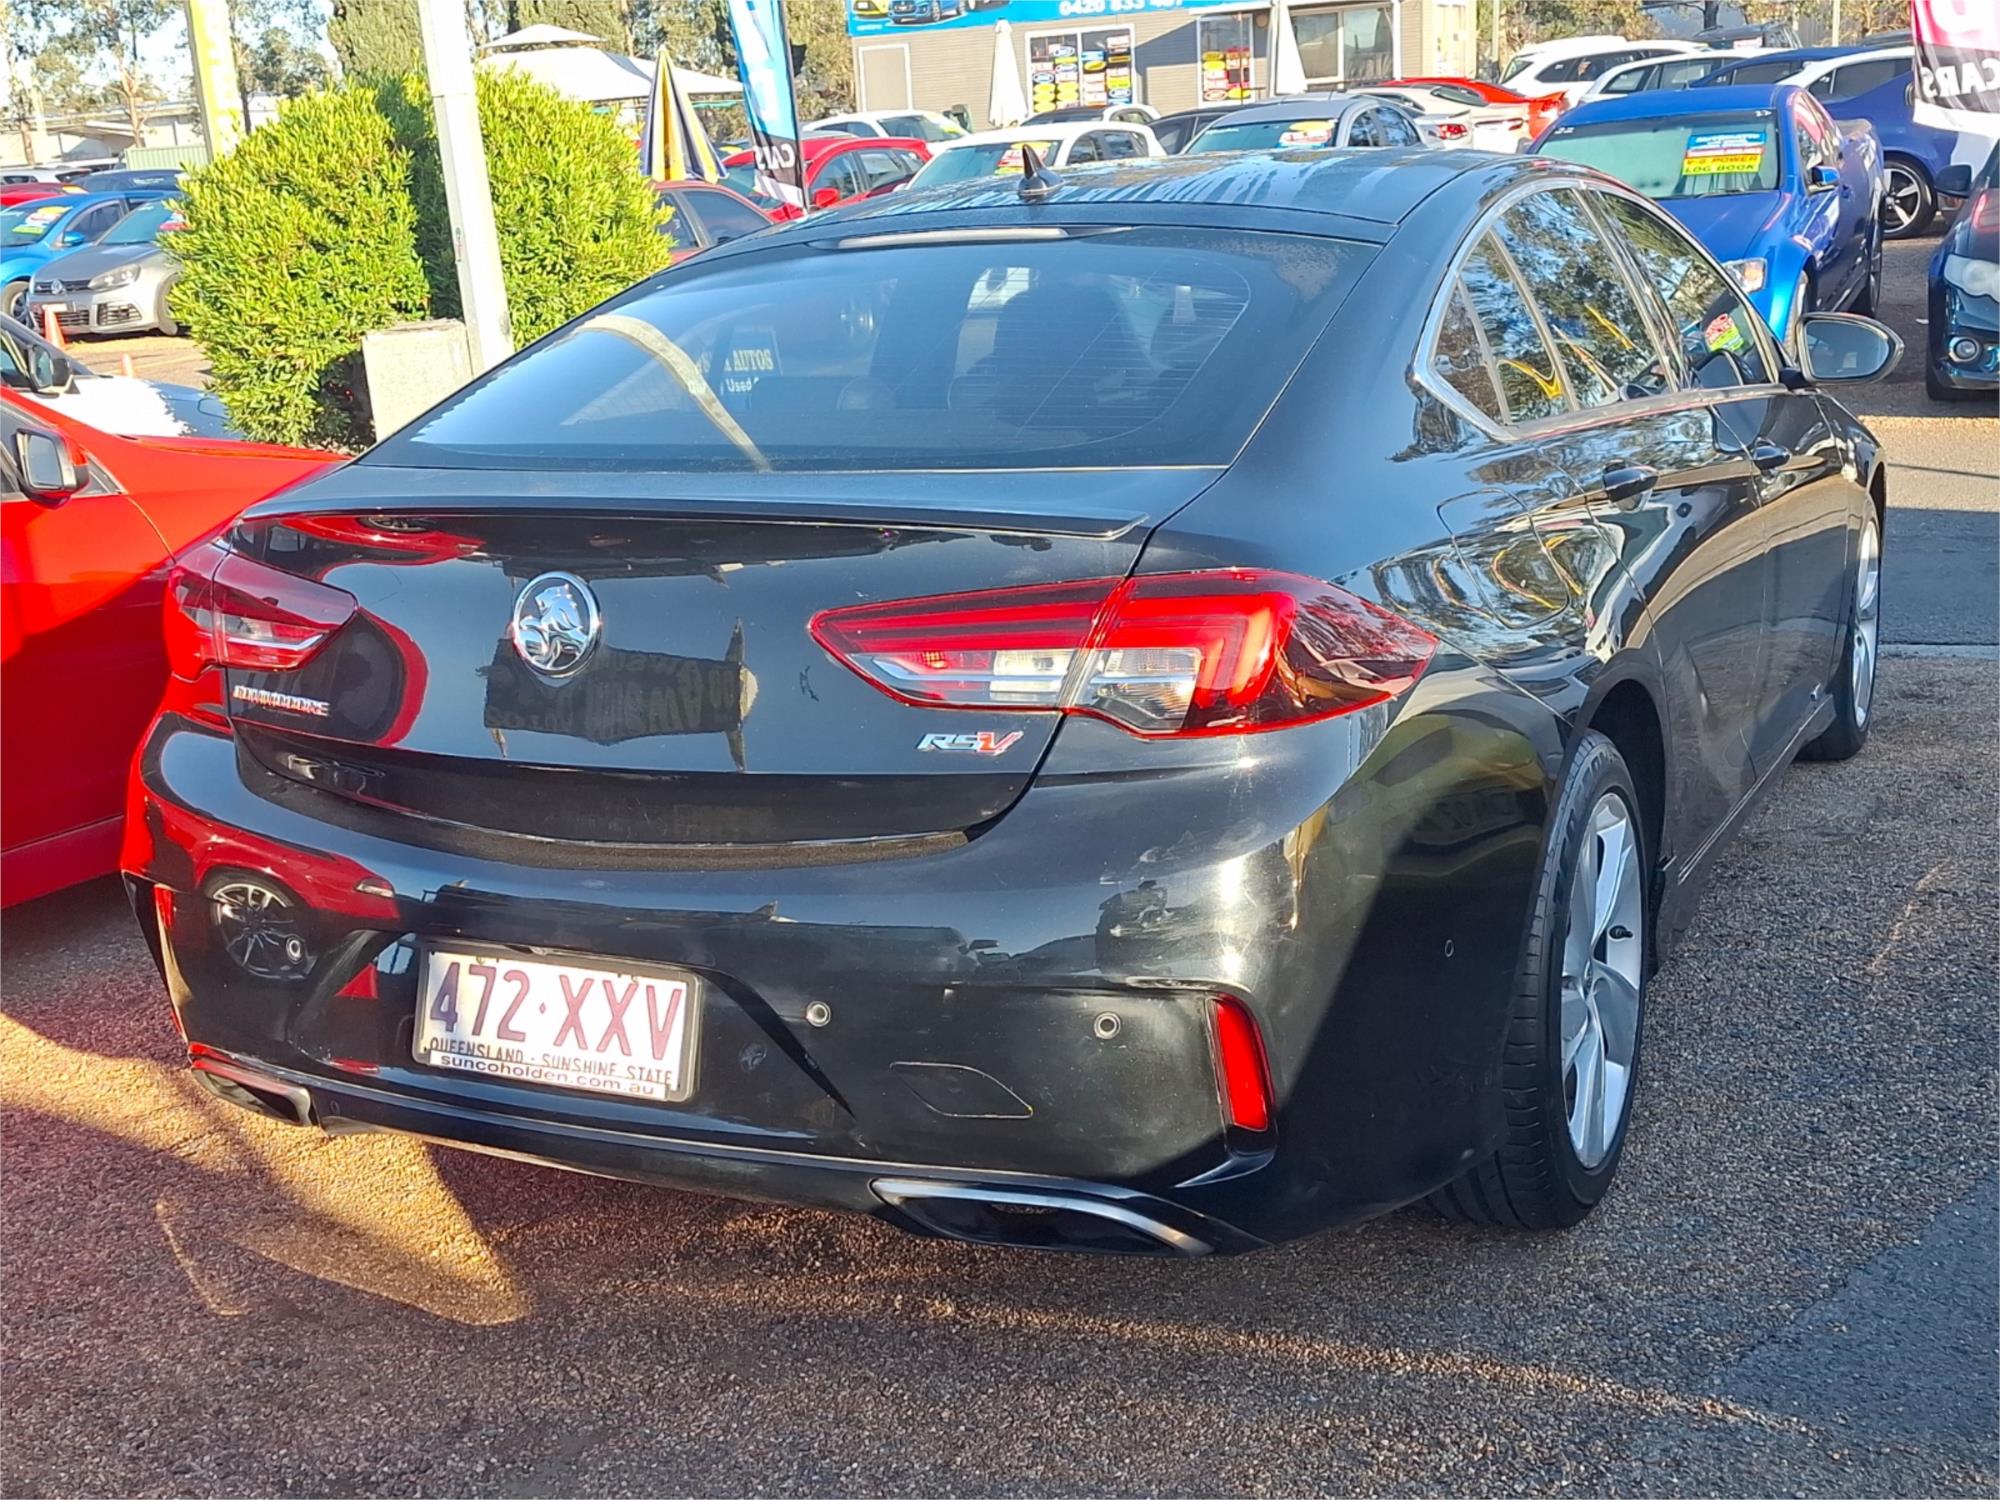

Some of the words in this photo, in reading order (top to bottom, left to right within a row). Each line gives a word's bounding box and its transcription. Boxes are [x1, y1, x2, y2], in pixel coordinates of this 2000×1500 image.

[733, 348, 774, 372] AUTOS
[726, 377, 752, 393] Used
[430, 1036, 524, 1063] QUEENSLAND
[542, 1055, 617, 1076] SUNSHINE
[626, 1065, 672, 1085] STATE
[440, 1054, 655, 1095] suncoholden.com.au
